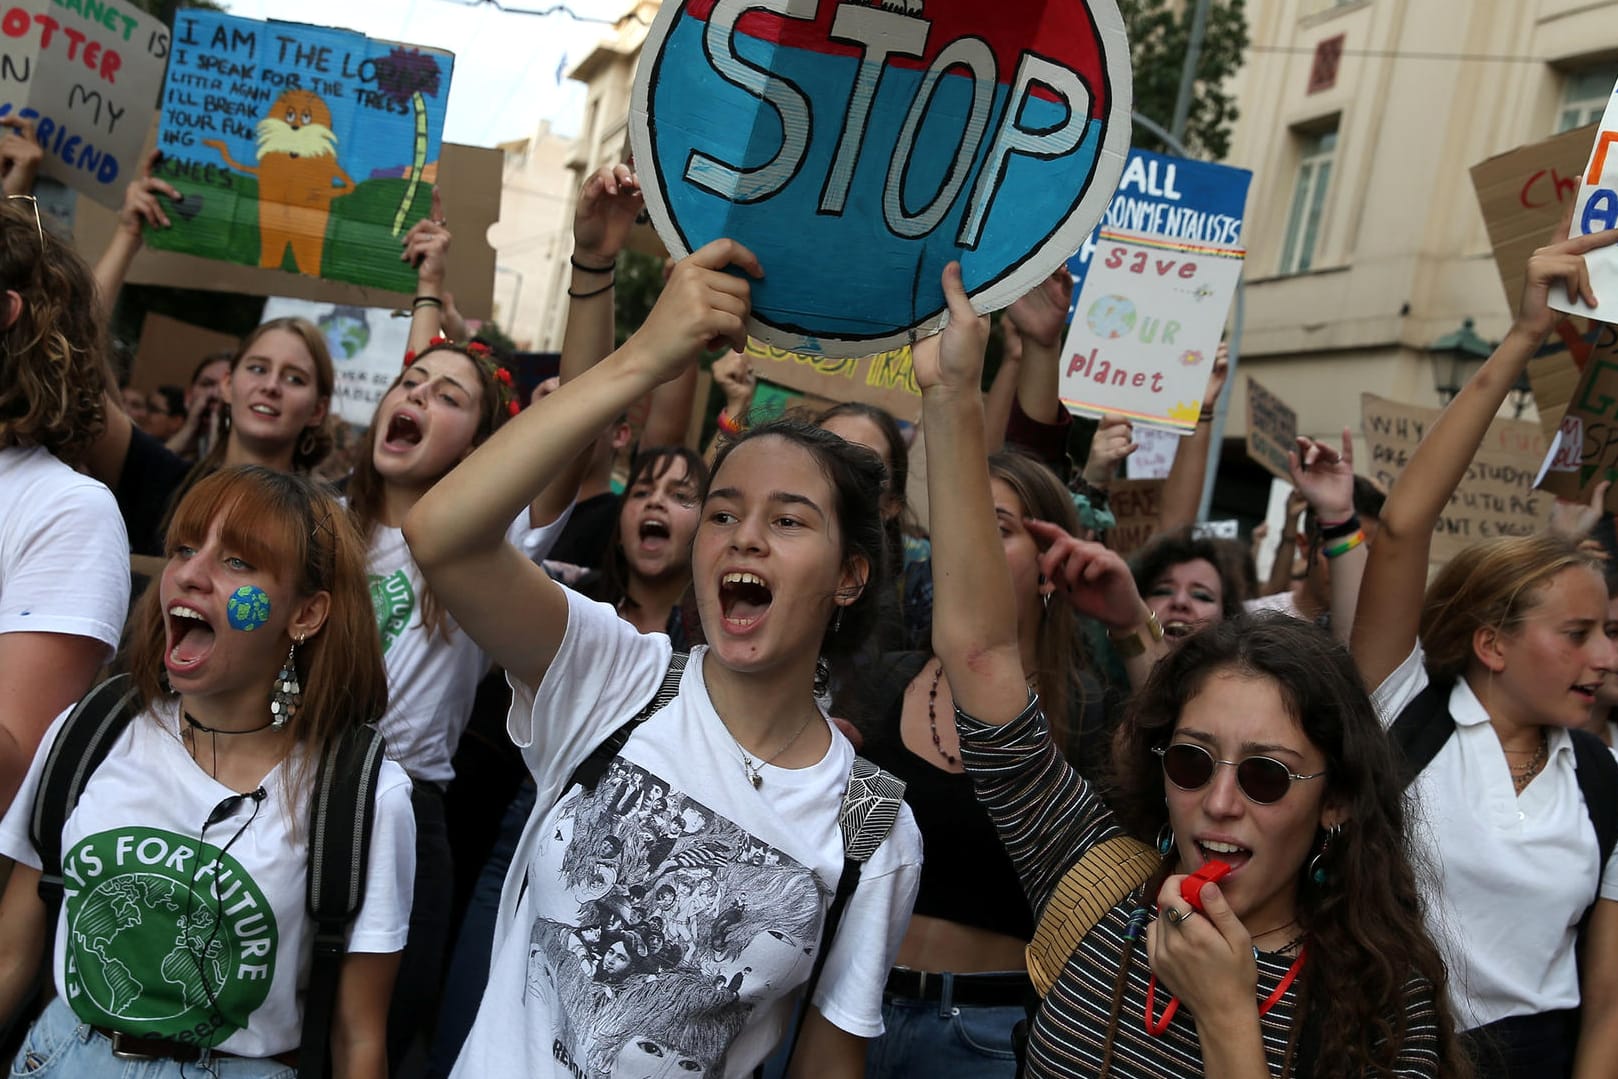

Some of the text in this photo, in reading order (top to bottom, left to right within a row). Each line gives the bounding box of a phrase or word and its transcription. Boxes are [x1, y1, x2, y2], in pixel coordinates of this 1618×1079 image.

[0, 6, 122, 84] OTTER
[54, 0, 168, 58] ANET IS
[178, 18, 199, 46] I
[211, 24, 256, 60] AM
[276, 35, 333, 73] THE
[176, 48, 410, 115] I SPEAK FOR THE TREES
[68, 84, 124, 134] MY
[166, 108, 217, 131] YOUR
[203, 94, 258, 119] BREAK
[683, 0, 1093, 250] STOP
[163, 129, 195, 147] ING
[1119, 156, 1182, 200] ALL
[1105, 247, 1198, 279] save
[1066, 348, 1165, 393] planet
[1369, 415, 1424, 444] WHY
[1373, 443, 1408, 469] ARE
[115, 835, 195, 873] FOR
[193, 858, 272, 981] FUTURE
